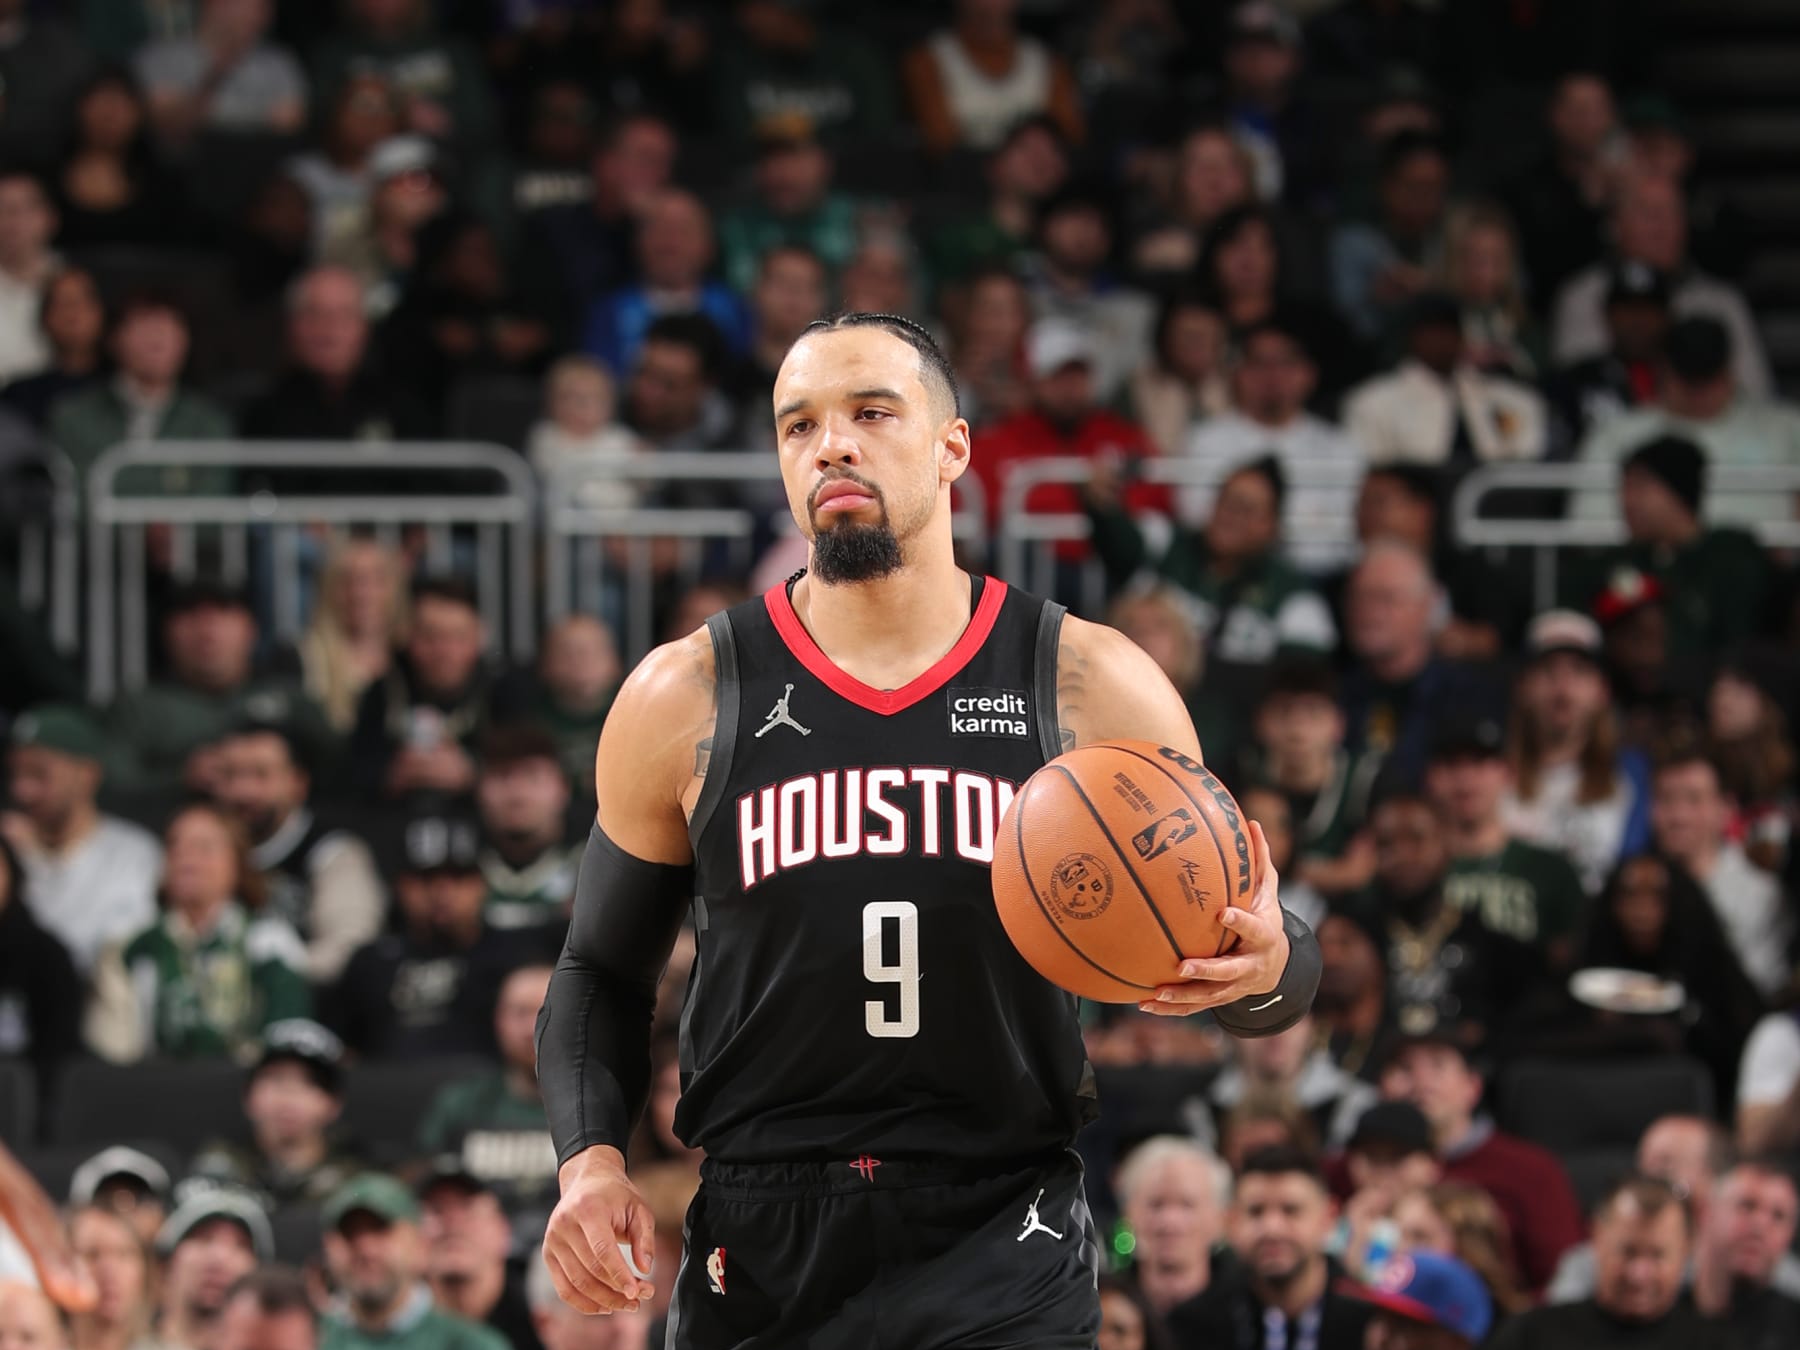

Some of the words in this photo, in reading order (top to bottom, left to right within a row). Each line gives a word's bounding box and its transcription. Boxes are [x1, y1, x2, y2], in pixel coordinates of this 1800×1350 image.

[954, 694, 1026, 714] credit
[951, 713, 1027, 735] karma
[862, 901, 920, 1038] 9
